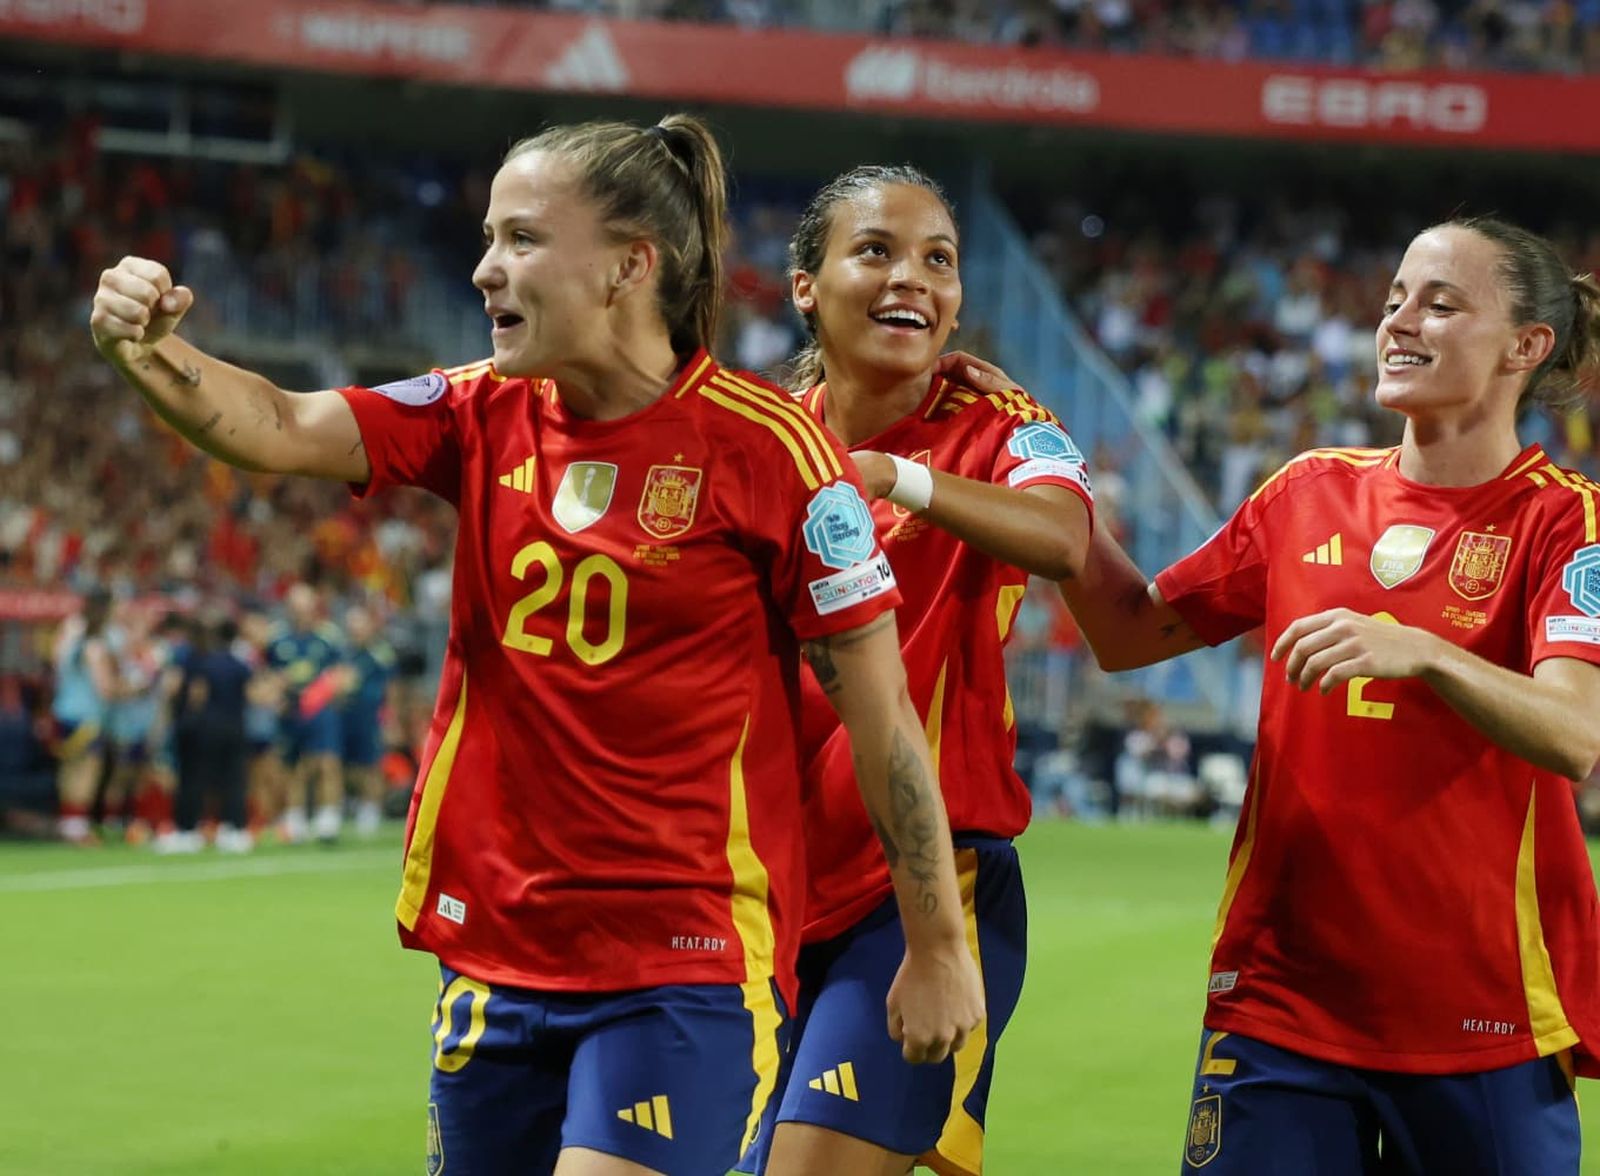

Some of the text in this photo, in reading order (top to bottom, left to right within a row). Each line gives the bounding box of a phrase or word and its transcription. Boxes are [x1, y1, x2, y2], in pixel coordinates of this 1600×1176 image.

[502, 541, 628, 666] 20
[672, 936, 726, 951] HEAT.RDY
[1463, 1018, 1516, 1036] HEAT.RDY
